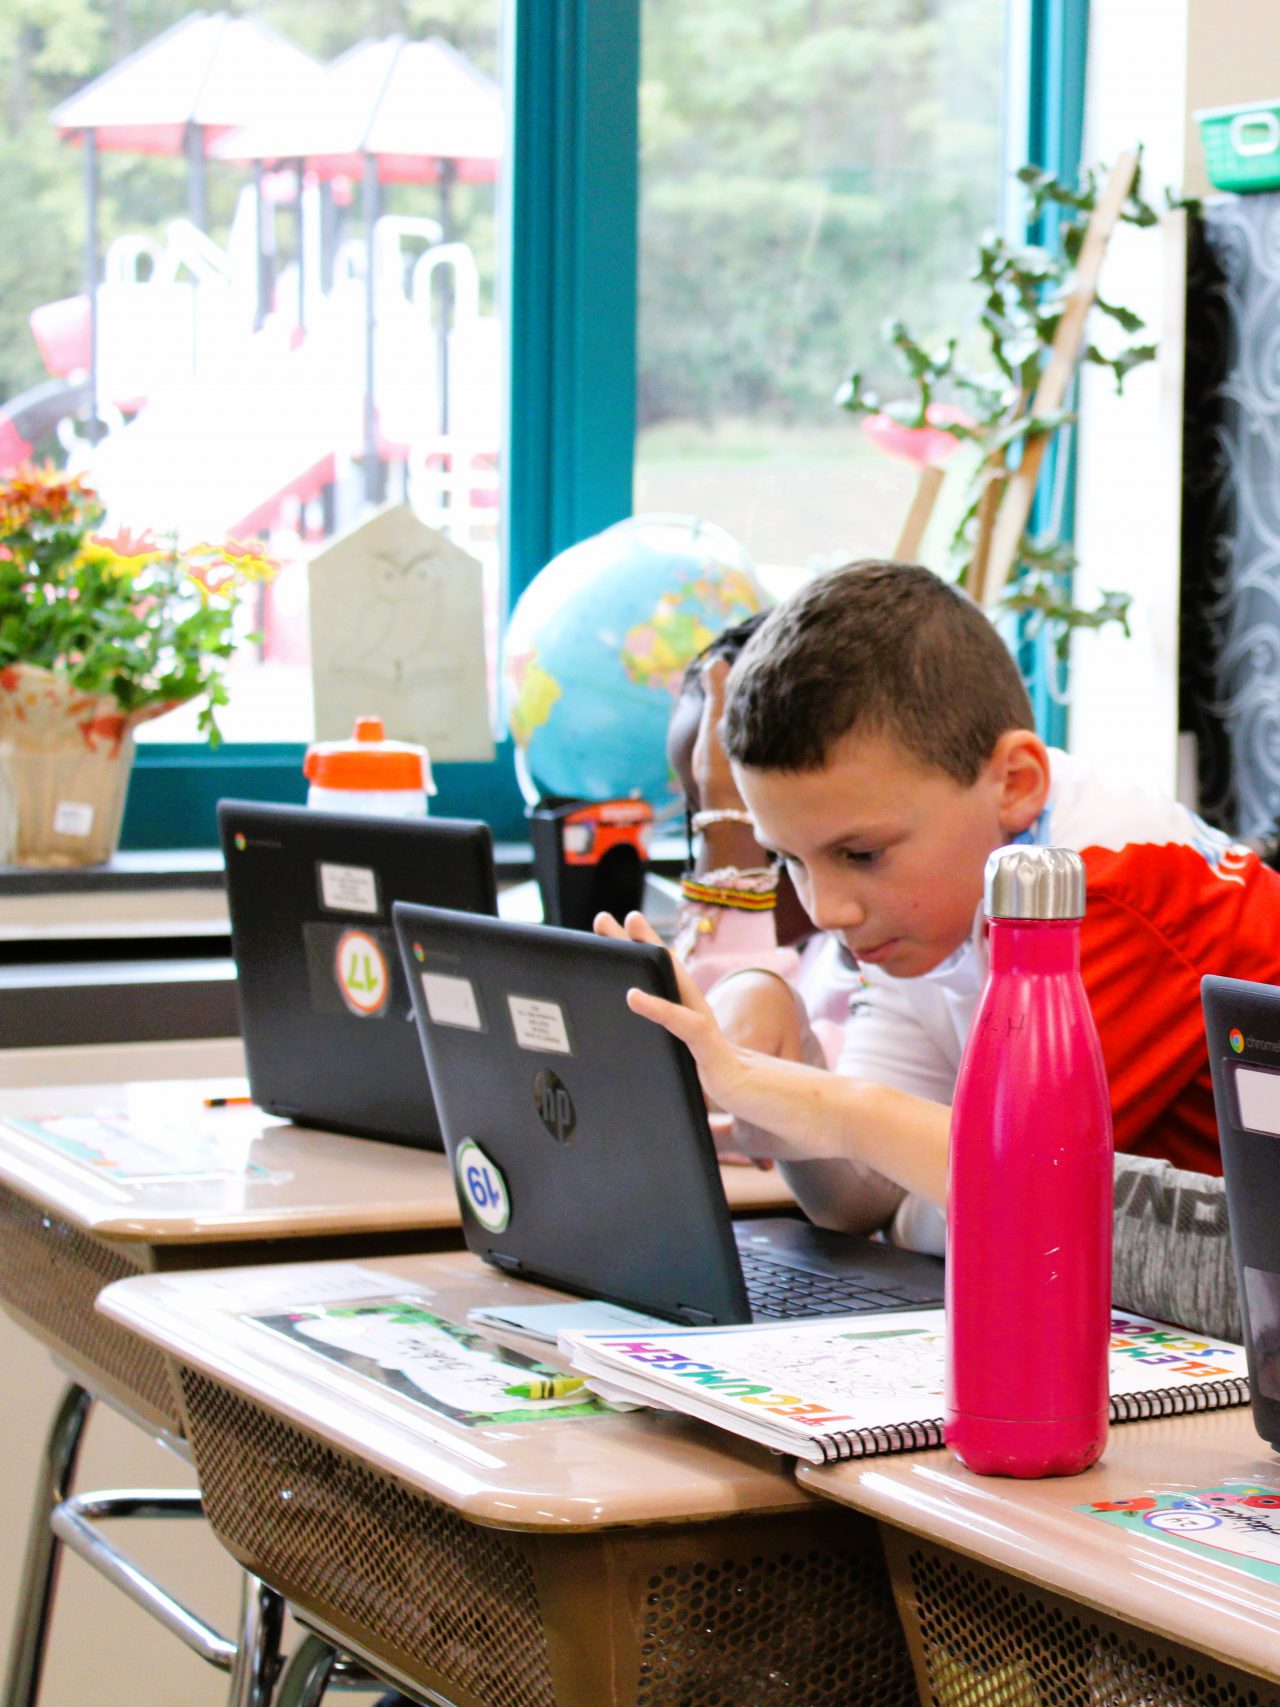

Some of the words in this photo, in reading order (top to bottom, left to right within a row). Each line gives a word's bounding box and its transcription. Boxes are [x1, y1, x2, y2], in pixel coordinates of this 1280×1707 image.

[347, 952, 379, 993] 17
[466, 1166, 500, 1209] 19
[600, 1341, 856, 1427] TECUMSEH
